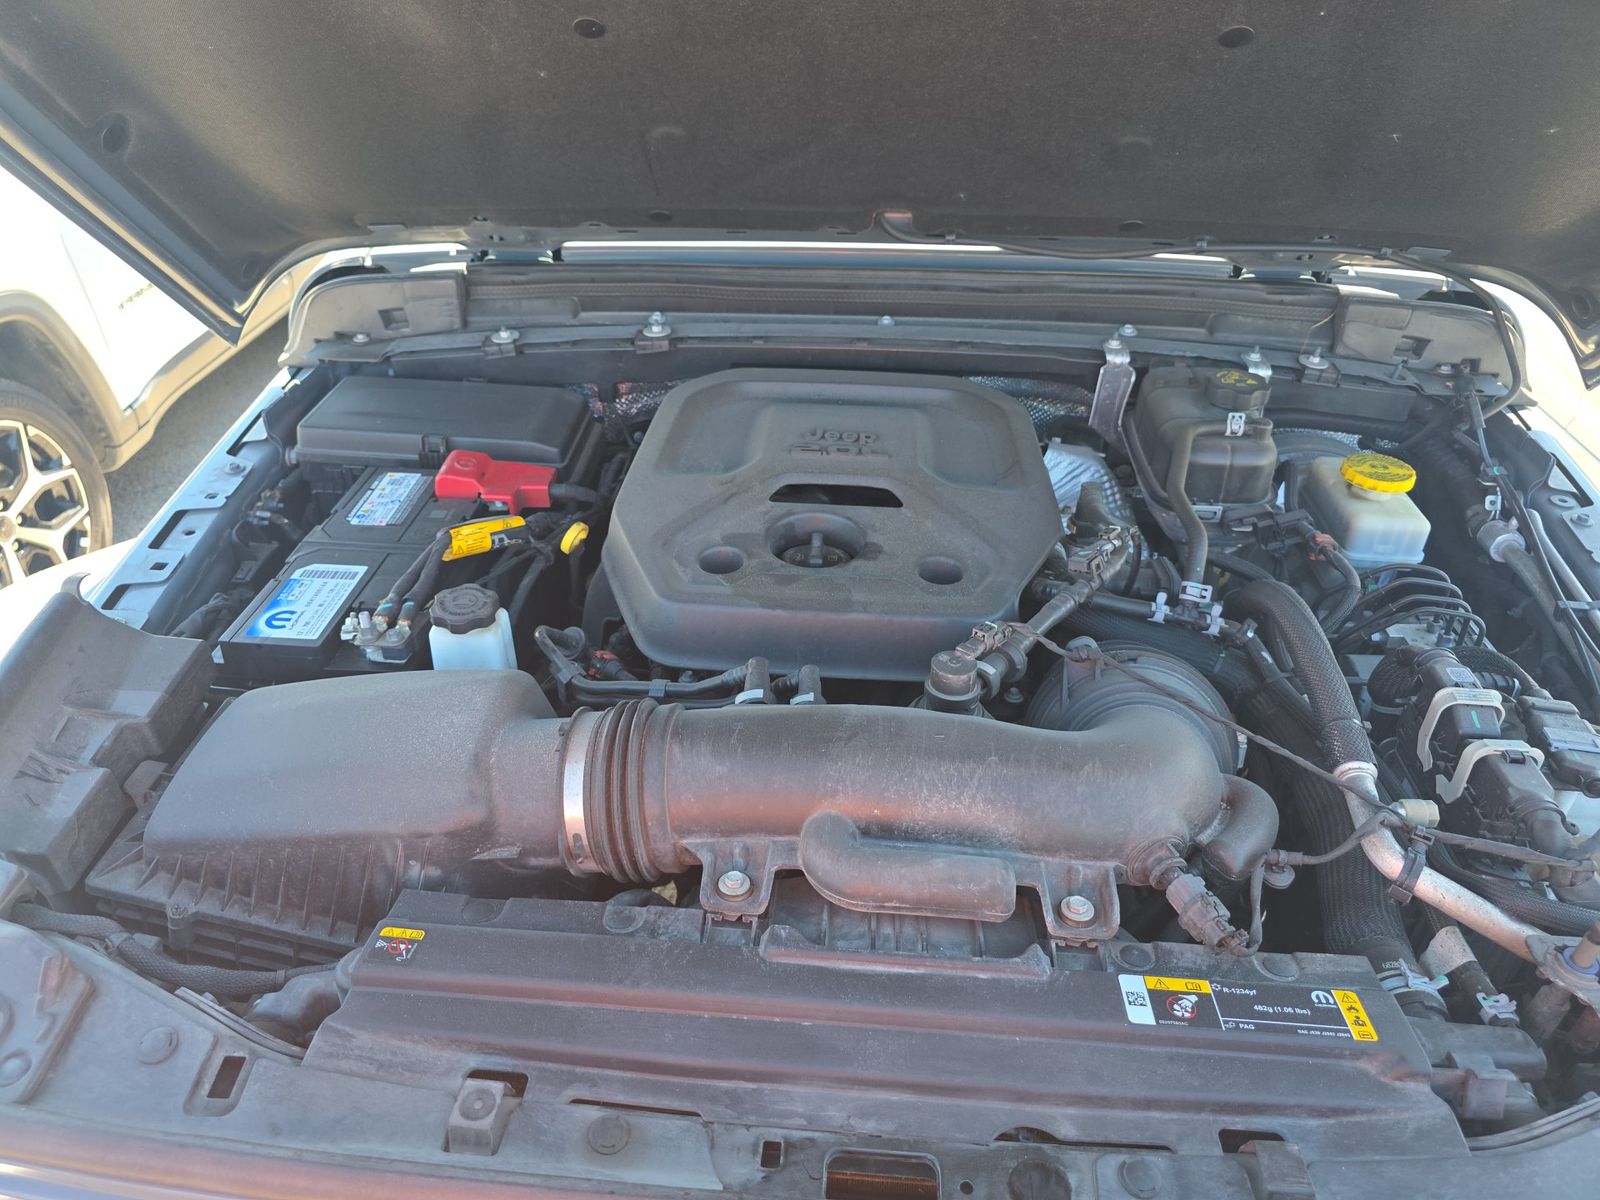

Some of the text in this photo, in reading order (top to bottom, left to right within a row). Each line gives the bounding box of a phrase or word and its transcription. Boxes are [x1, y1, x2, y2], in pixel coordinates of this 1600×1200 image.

[801, 429, 878, 445] Jeep
[1222, 987, 1257, 996] R-1234yf
[1253, 1004, 1273, 1013] 482g
